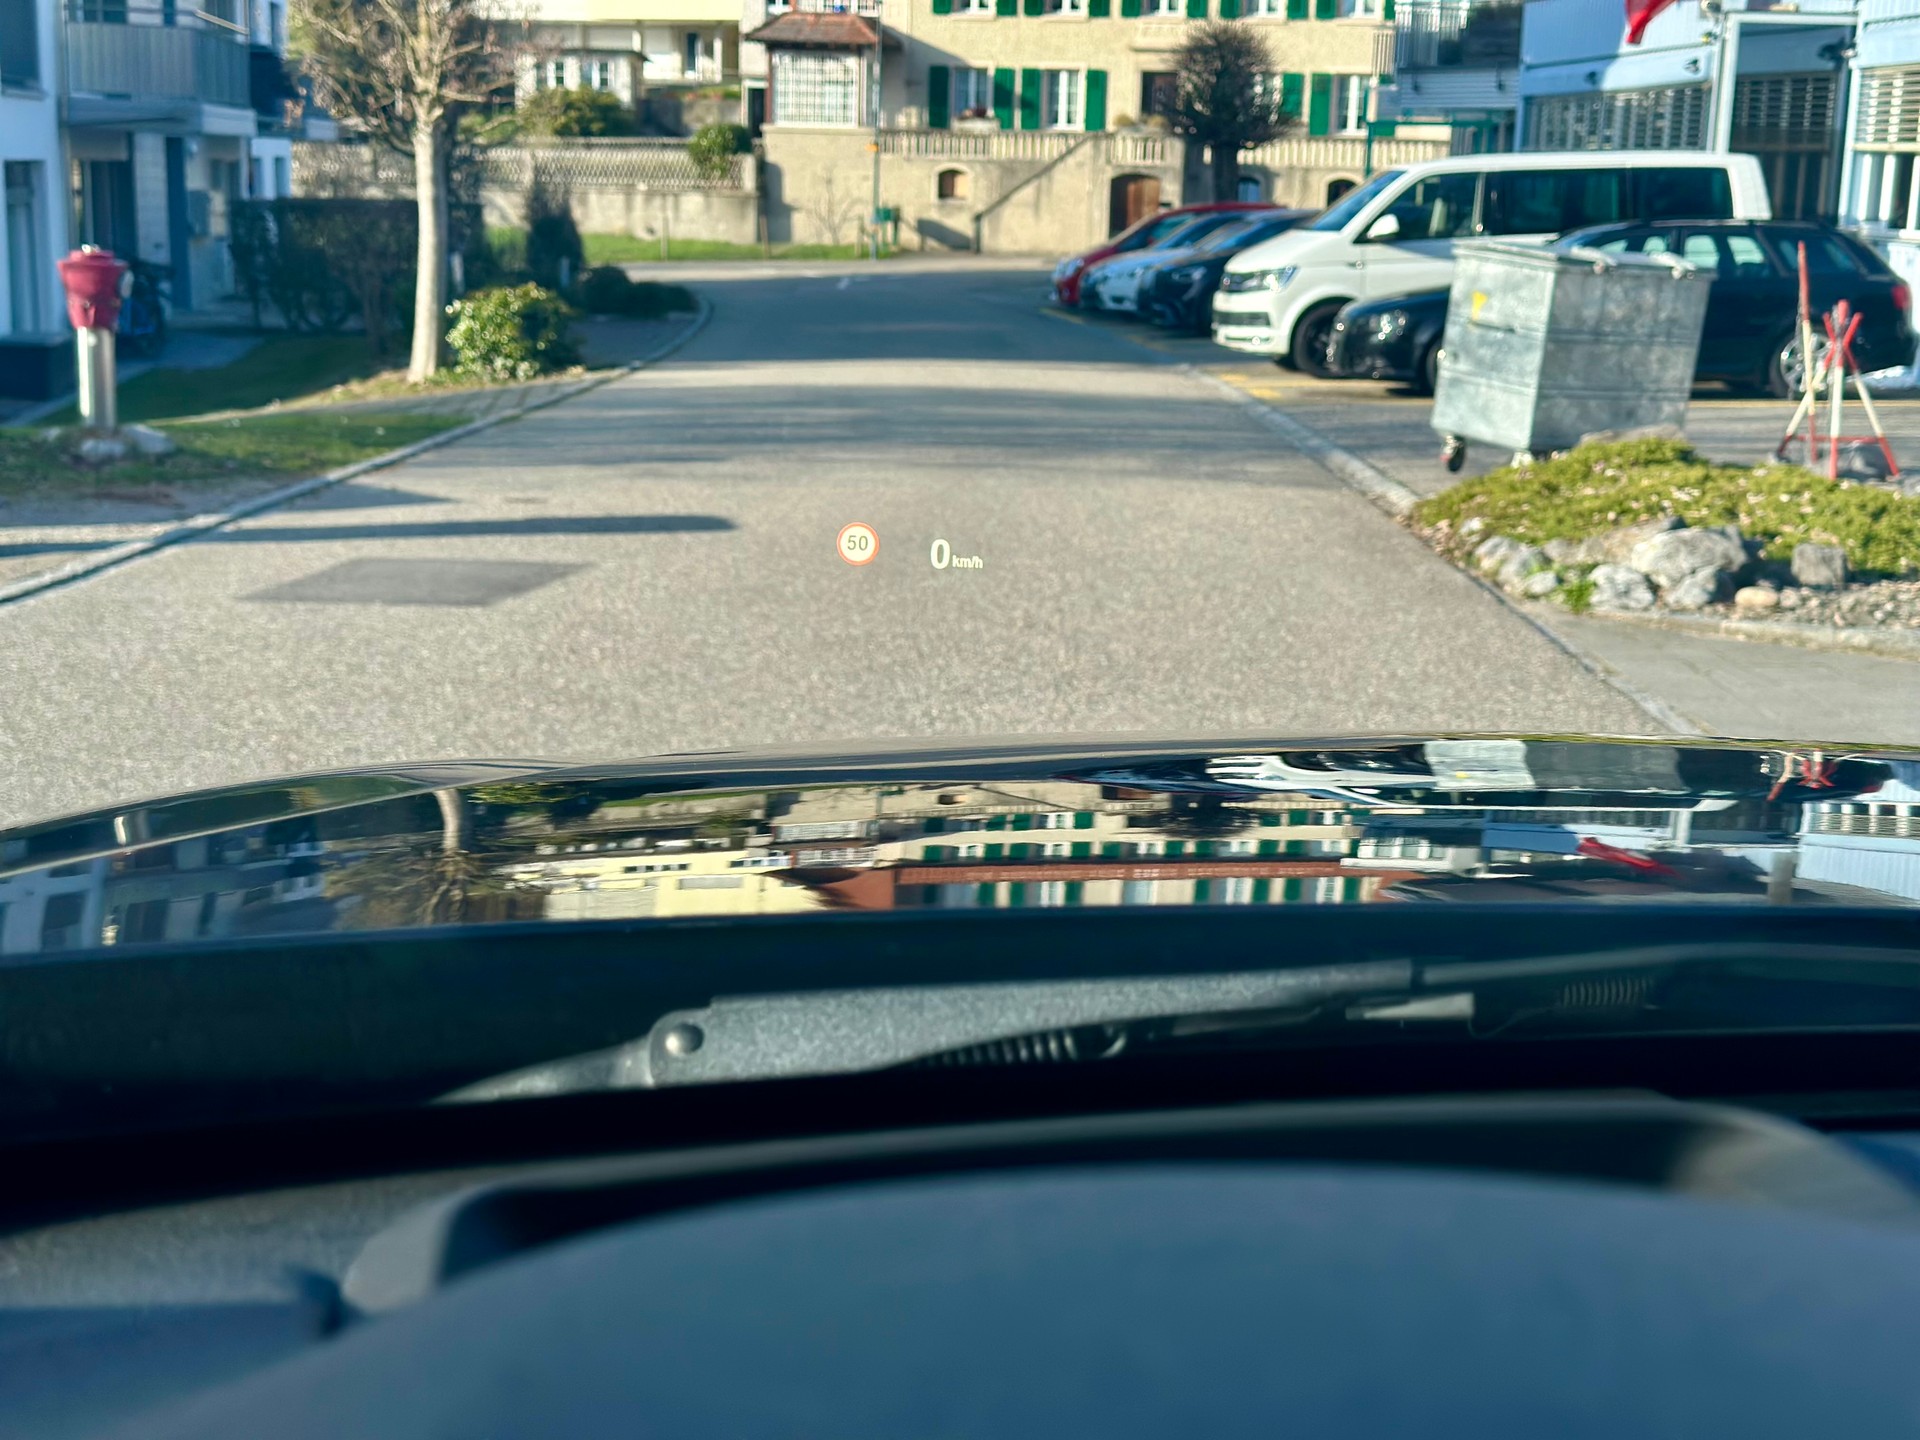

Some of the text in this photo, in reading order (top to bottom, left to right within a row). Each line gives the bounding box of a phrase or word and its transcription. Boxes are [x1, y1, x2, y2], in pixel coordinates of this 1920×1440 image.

[847, 535, 869, 551] 50
[930, 538, 983, 570] 0 km/h
